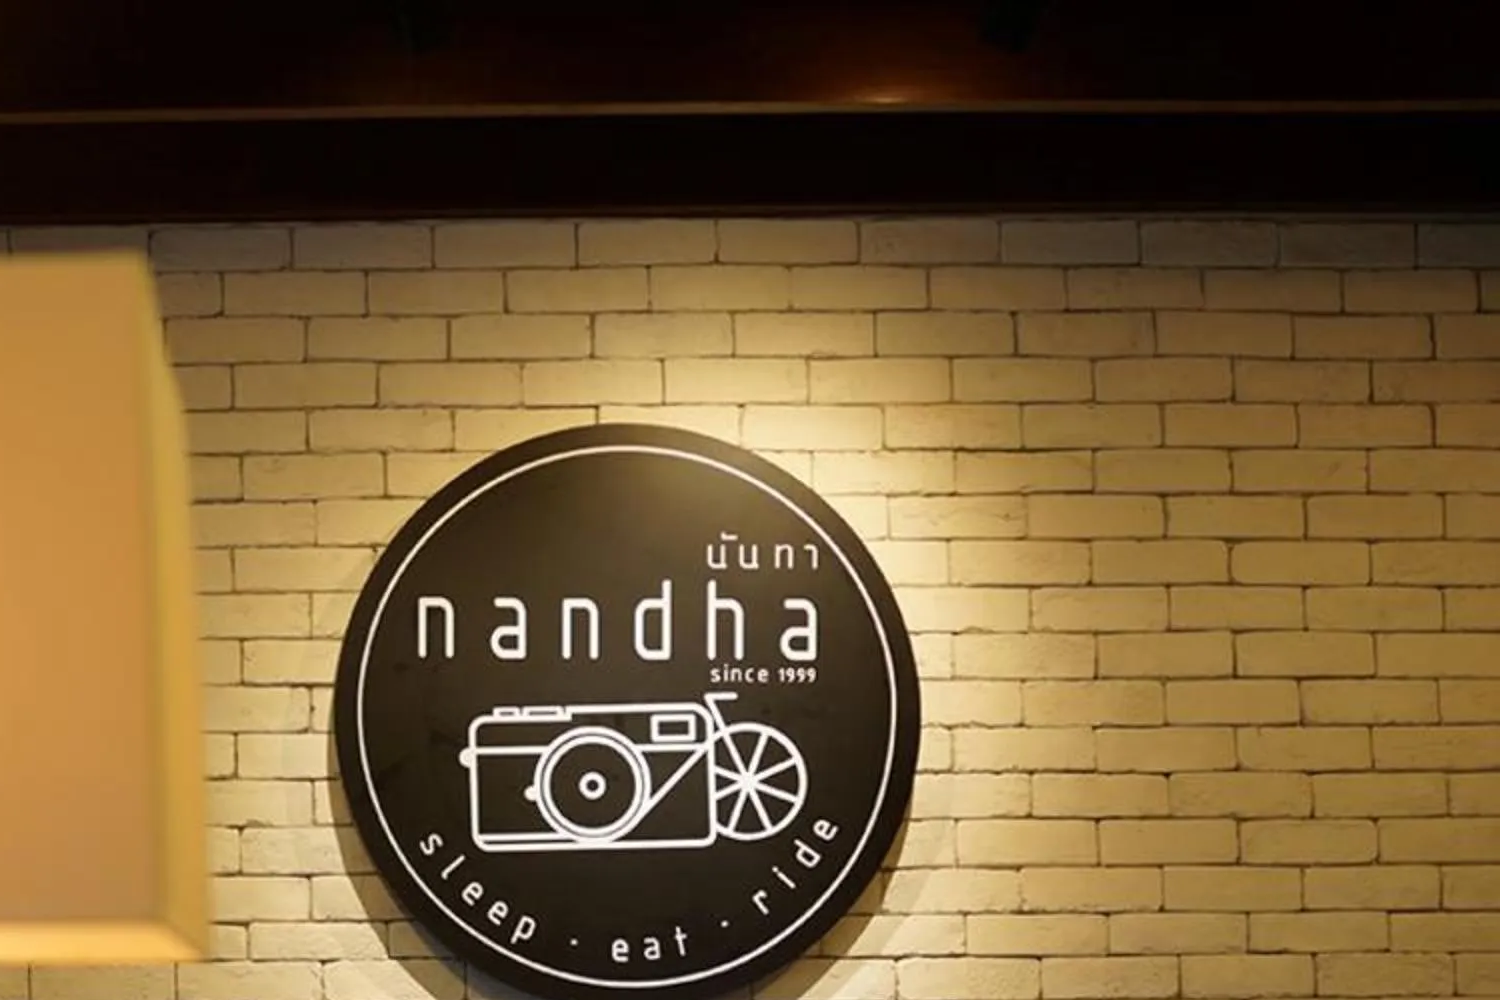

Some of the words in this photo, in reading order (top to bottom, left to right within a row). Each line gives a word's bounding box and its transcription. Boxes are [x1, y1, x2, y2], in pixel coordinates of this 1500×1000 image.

[706, 531, 819, 570] นันทา
[417, 578, 819, 662] nandha
[709, 664, 769, 684] since
[777, 667, 817, 684] 1999
[418, 831, 537, 945] sleep
[610, 926, 688, 963] eat
[751, 818, 839, 916] ride
